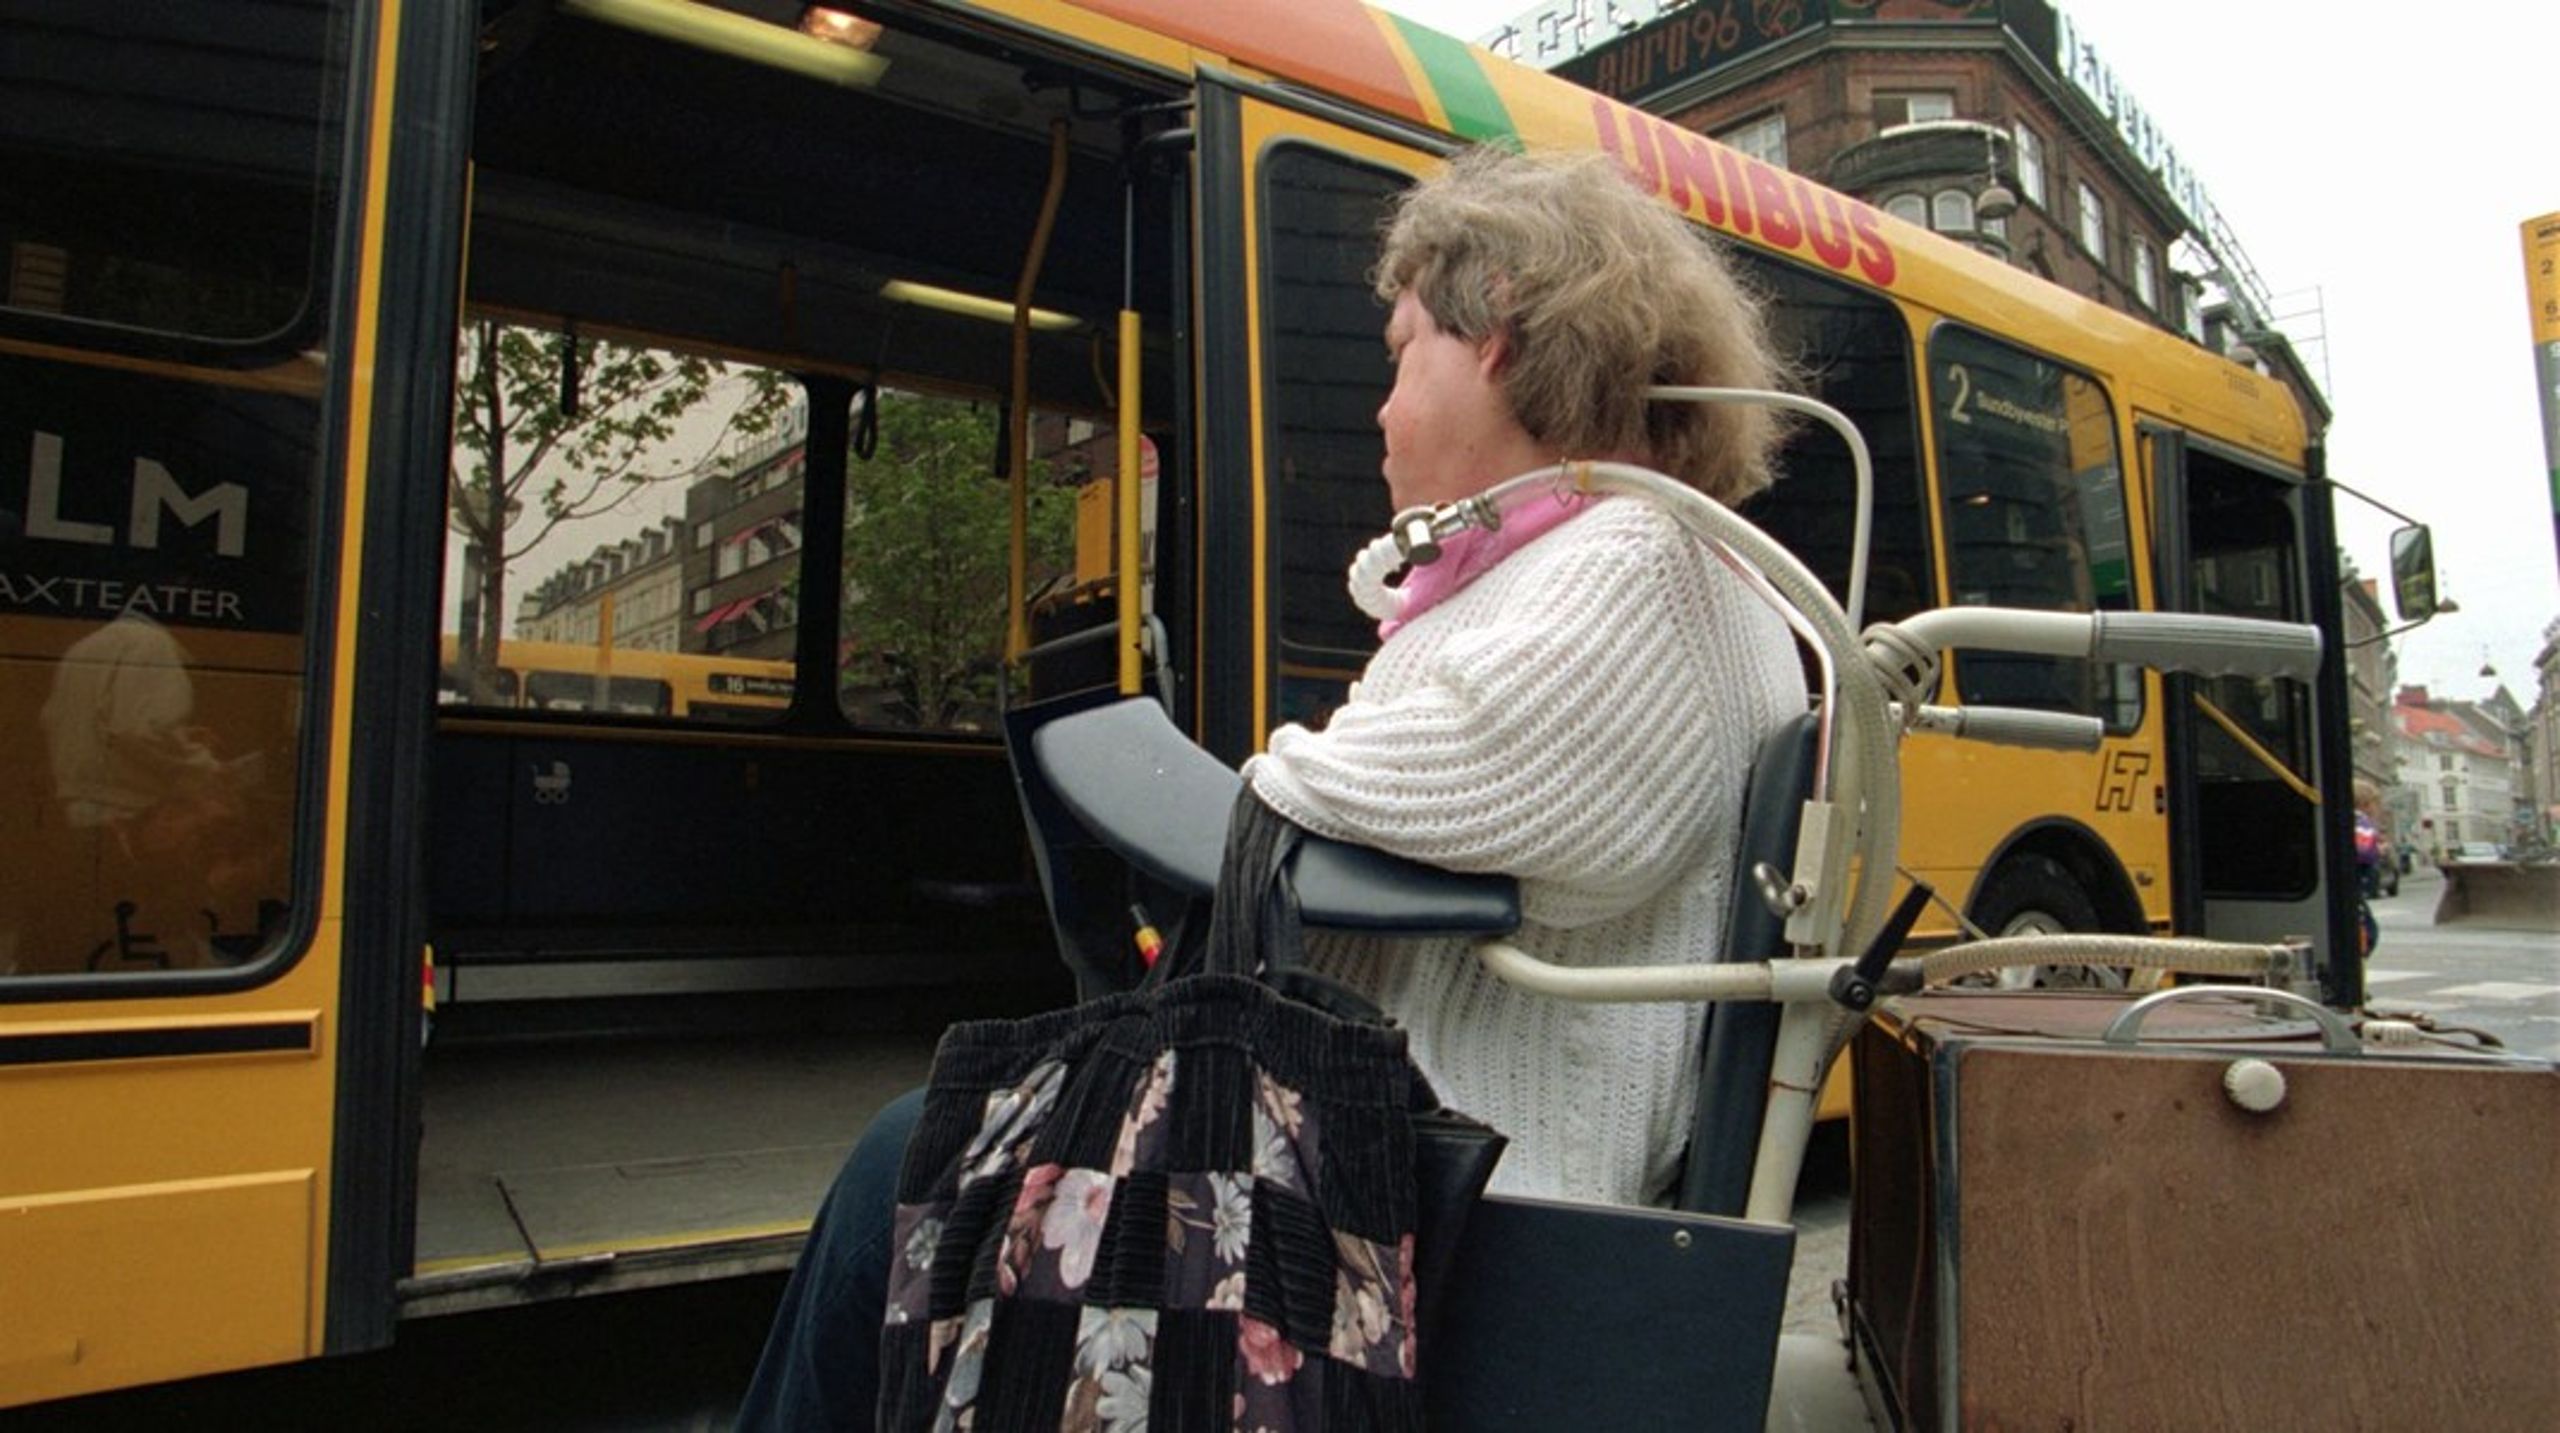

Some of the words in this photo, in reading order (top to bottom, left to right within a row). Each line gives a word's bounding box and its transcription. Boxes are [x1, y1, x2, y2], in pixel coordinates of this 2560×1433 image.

[1591, 97, 1896, 287] UNIBUS
[1948, 363, 1972, 425] 2
[25, 430, 248, 557] LM
[727, 676, 745, 693] 16
